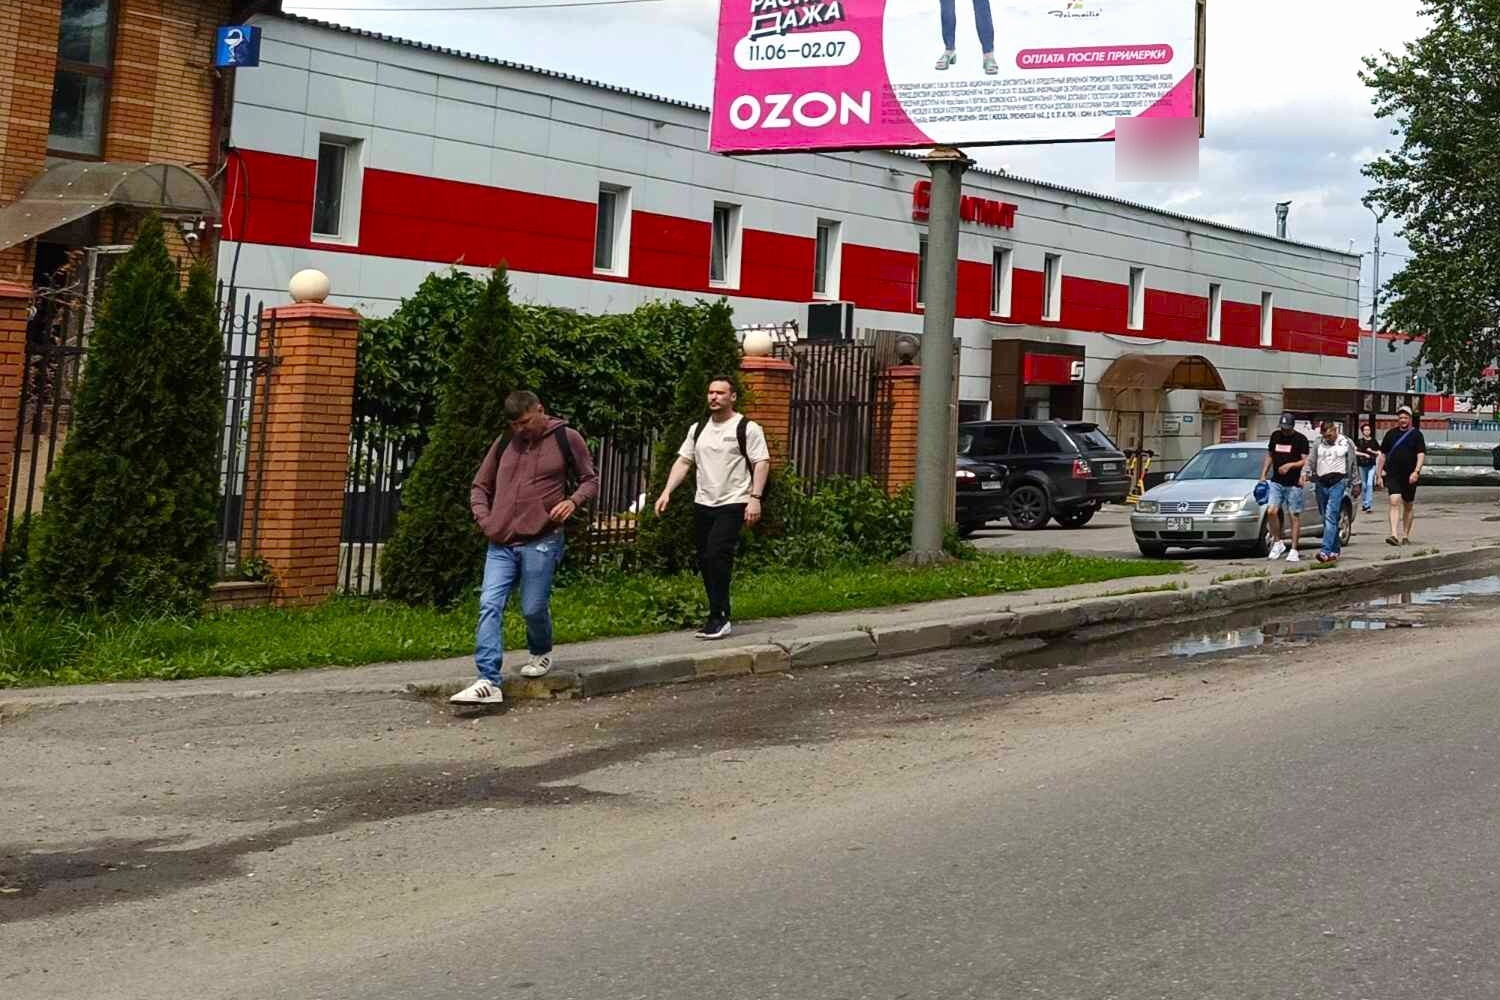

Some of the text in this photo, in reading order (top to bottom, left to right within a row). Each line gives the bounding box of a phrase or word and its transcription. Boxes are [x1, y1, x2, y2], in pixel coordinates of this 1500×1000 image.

[749, 0, 841, 37] ДАЖА
[1021, 49, 1167, 64] ОПЛАТА ПОСЛЕ ПРИМЕРКИ
[729, 90, 872, 131] OZON
